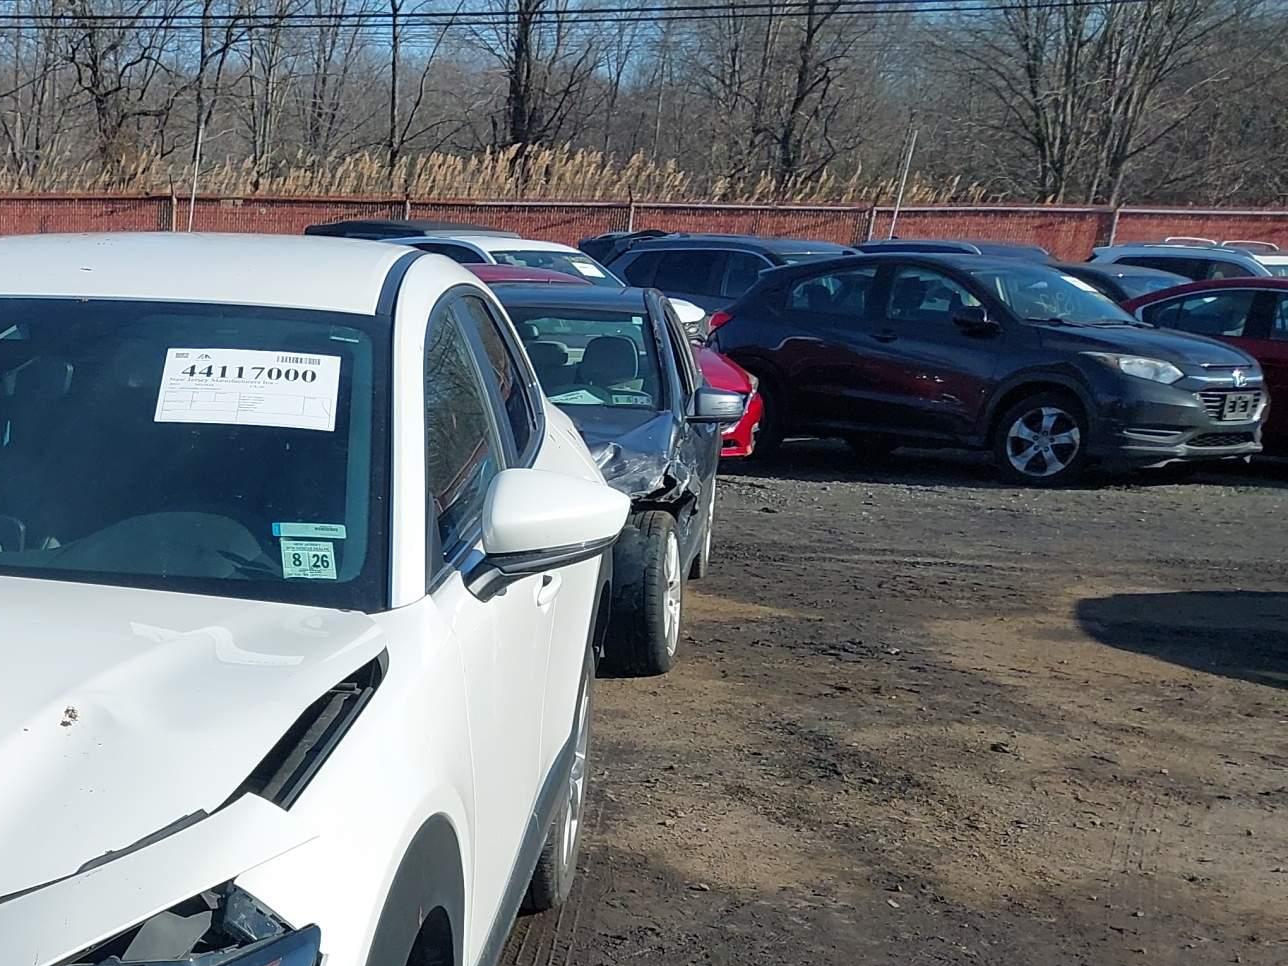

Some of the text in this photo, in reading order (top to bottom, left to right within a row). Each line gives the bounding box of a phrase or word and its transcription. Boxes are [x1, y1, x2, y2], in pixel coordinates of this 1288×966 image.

[181, 364, 317, 383] 44117000
[292, 553, 330, 568] 8 26
